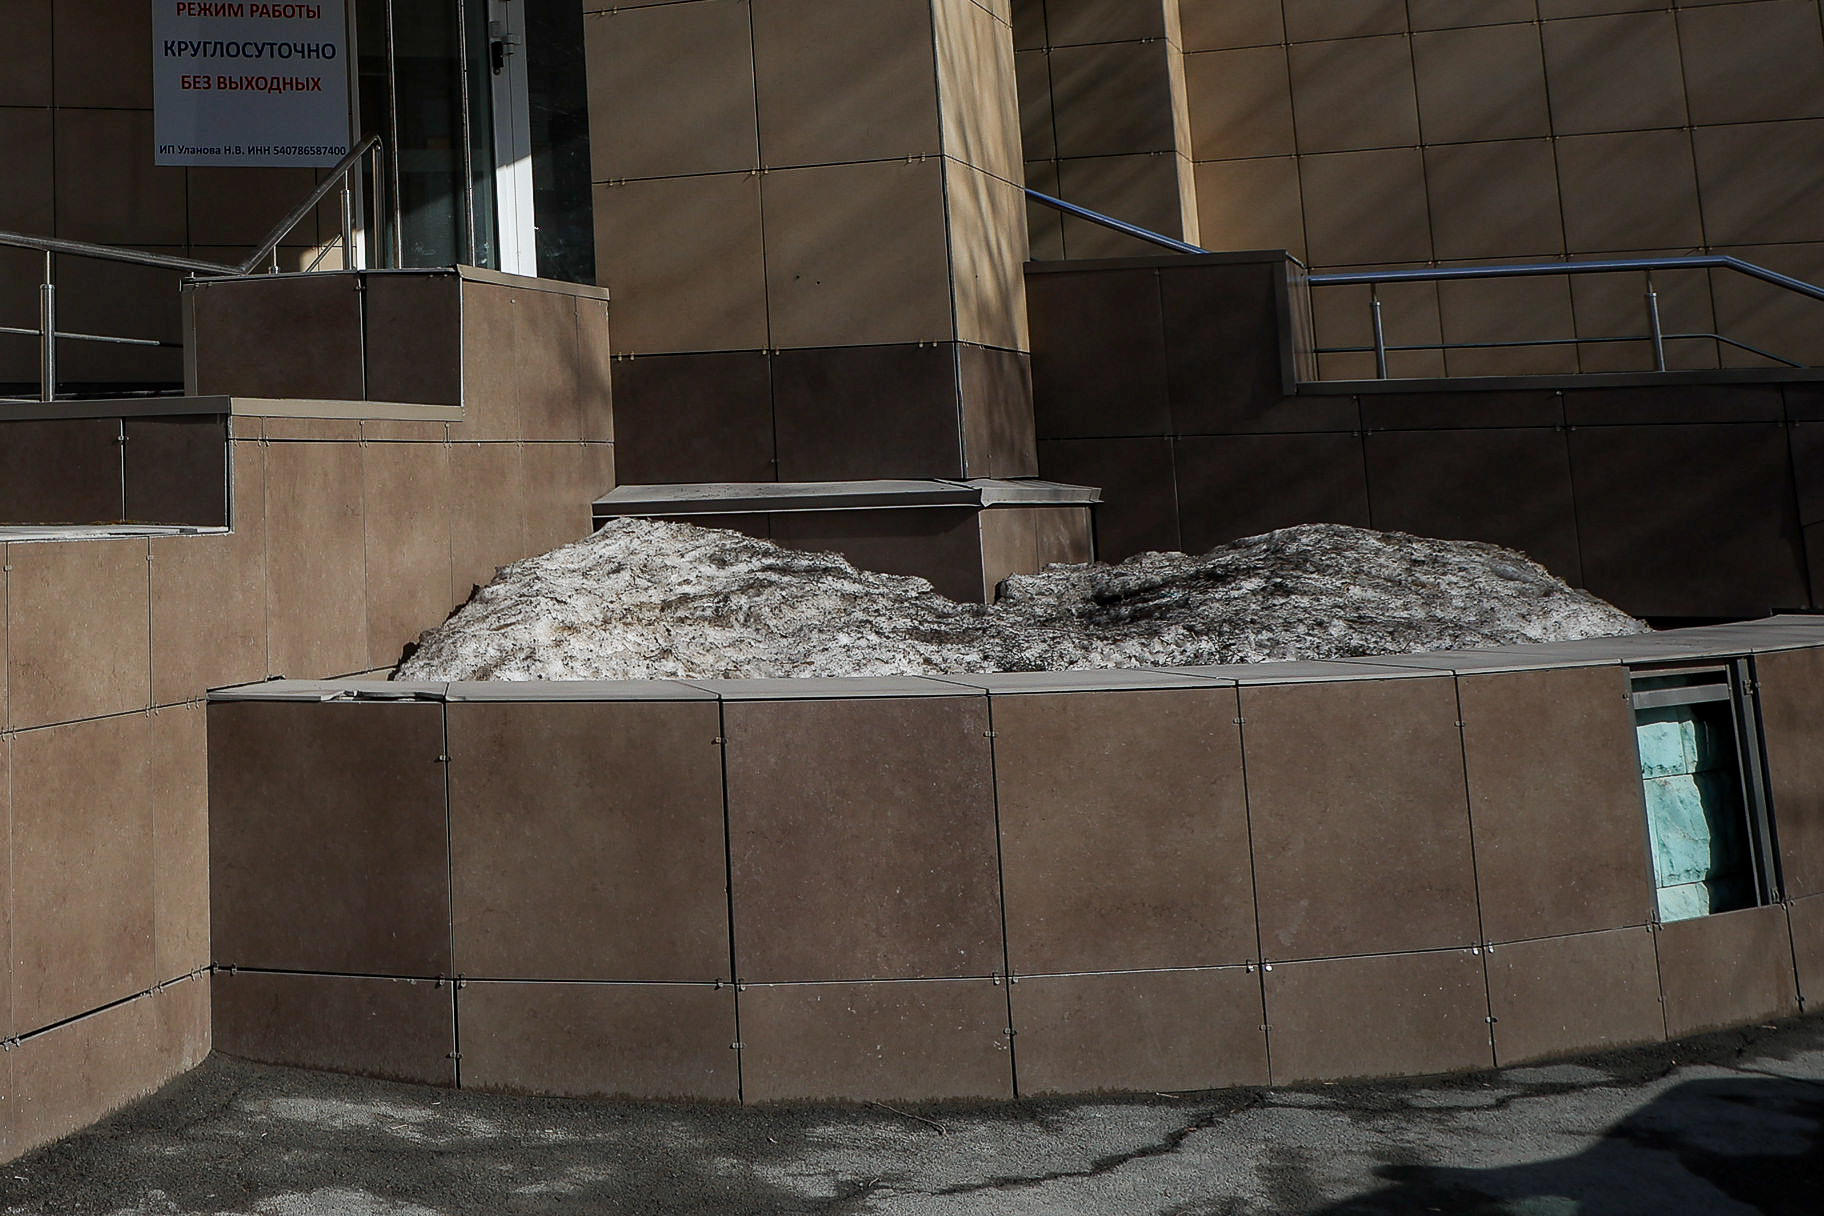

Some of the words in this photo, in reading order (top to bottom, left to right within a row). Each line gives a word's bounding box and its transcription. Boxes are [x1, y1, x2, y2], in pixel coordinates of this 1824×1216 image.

[176, 2, 244, 18] РЕЖИМ
[249, 3, 321, 19] РАБОТЫ
[164, 40, 337, 60] КРУГЛОСУТОЧНО
[181, 75, 212, 90] БЕЗ
[217, 76, 322, 93] ВЫХОДНЫХ
[159, 145, 175, 155] ИП
[178, 145, 221, 155] Уланова
[224, 145, 245, 155] Н.В.
[248, 146, 270, 155] ИНН
[273, 146, 346, 156] 540786587400
